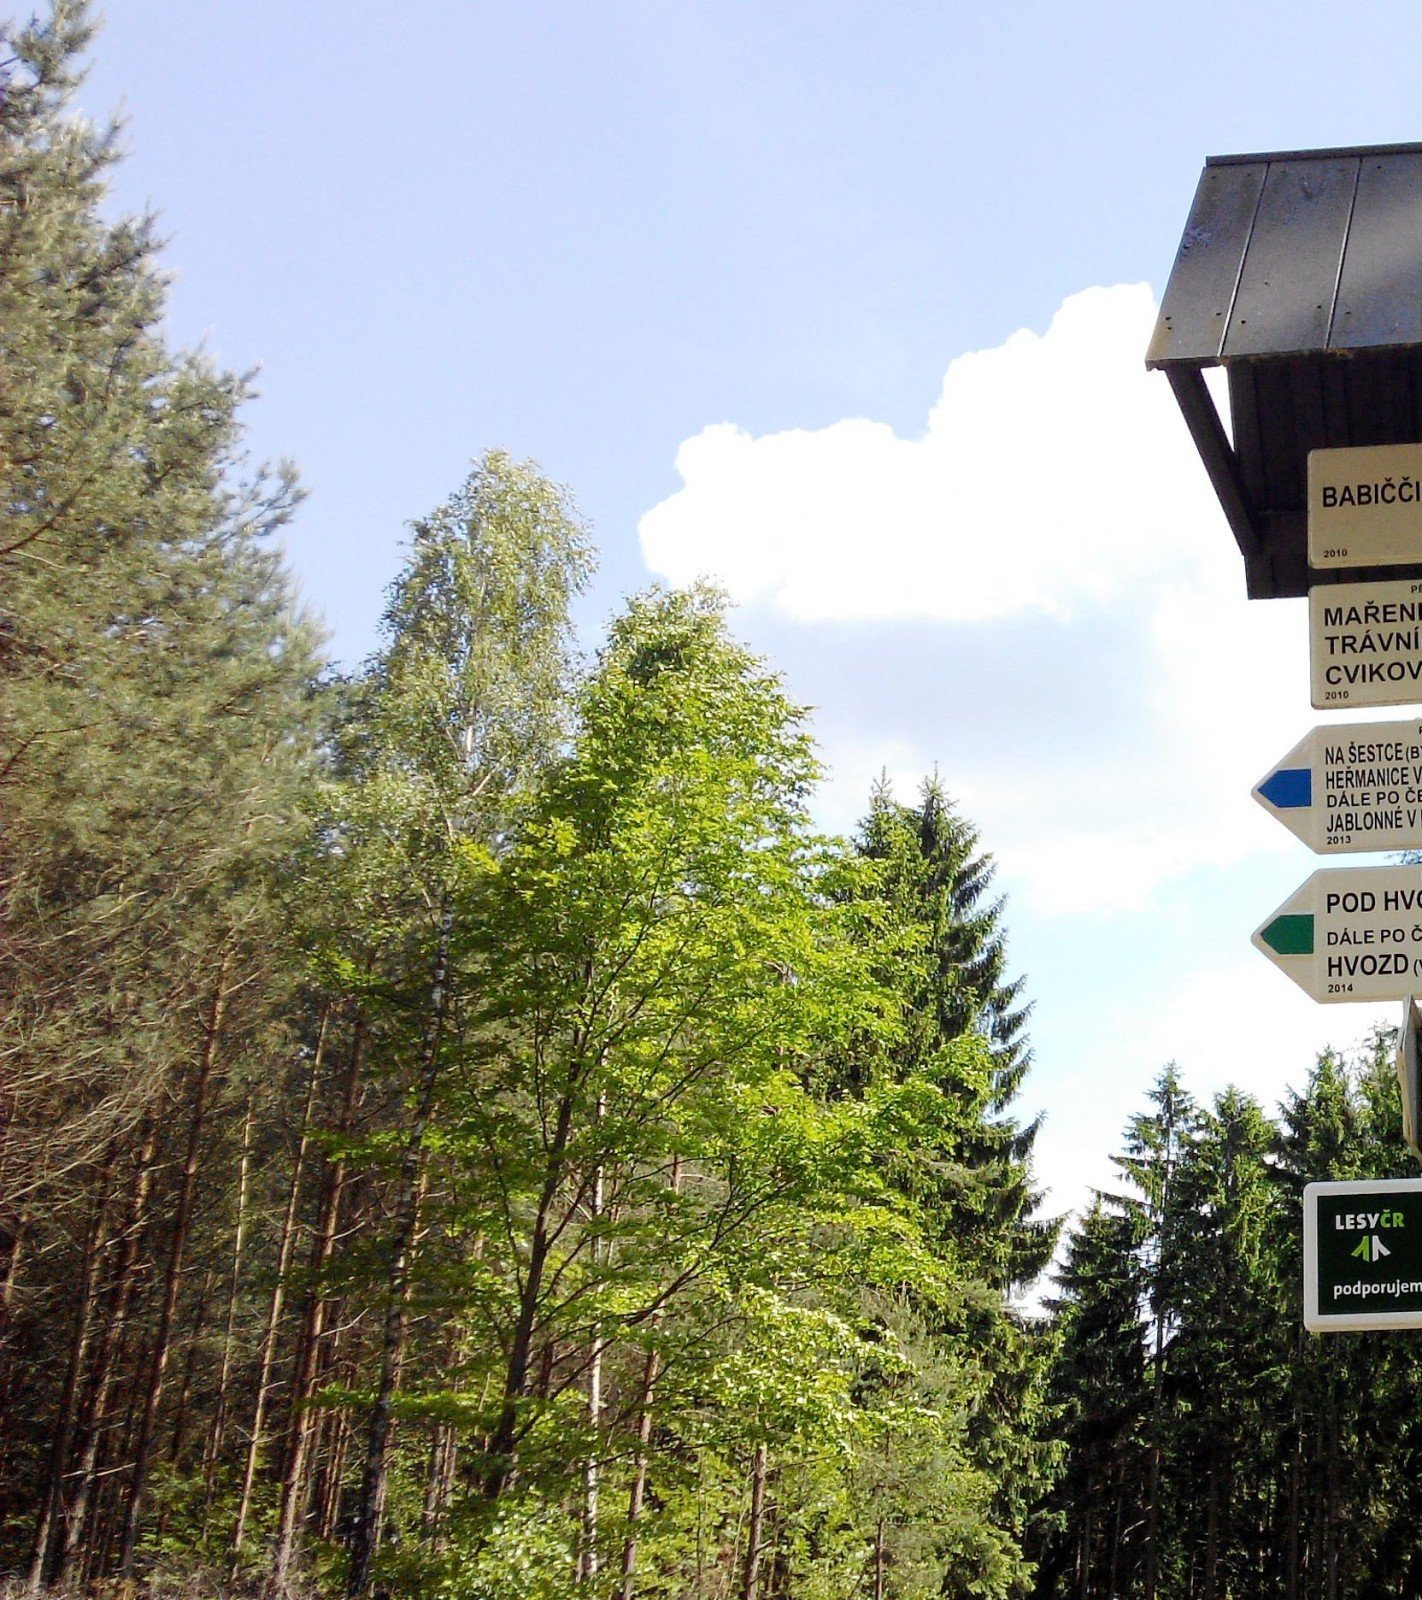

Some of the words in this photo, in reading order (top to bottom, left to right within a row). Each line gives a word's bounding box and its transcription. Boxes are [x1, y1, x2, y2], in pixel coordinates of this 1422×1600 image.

[1323, 549, 1348, 558] 2010
[1325, 690, 1349, 700] 2010
[1325, 747, 1344, 765] NA
[1349, 742, 1403, 763] ŠESTCE
[1326, 766, 1409, 789] HEŘMANICE
[1413, 766, 1422, 784] V
[1327, 791, 1370, 808] DÁLE
[1377, 791, 1399, 805] PO
[1327, 806, 1403, 832] JABLONNÉ
[1407, 810, 1417, 827] V
[1327, 836, 1351, 845] 2013
[1327, 892, 1376, 914] POD
[1327, 928, 1374, 946] DÁLE
[1381, 927, 1405, 943] PO
[1327, 953, 1408, 977] HVOZD
[1328, 983, 1353, 993] 2014
